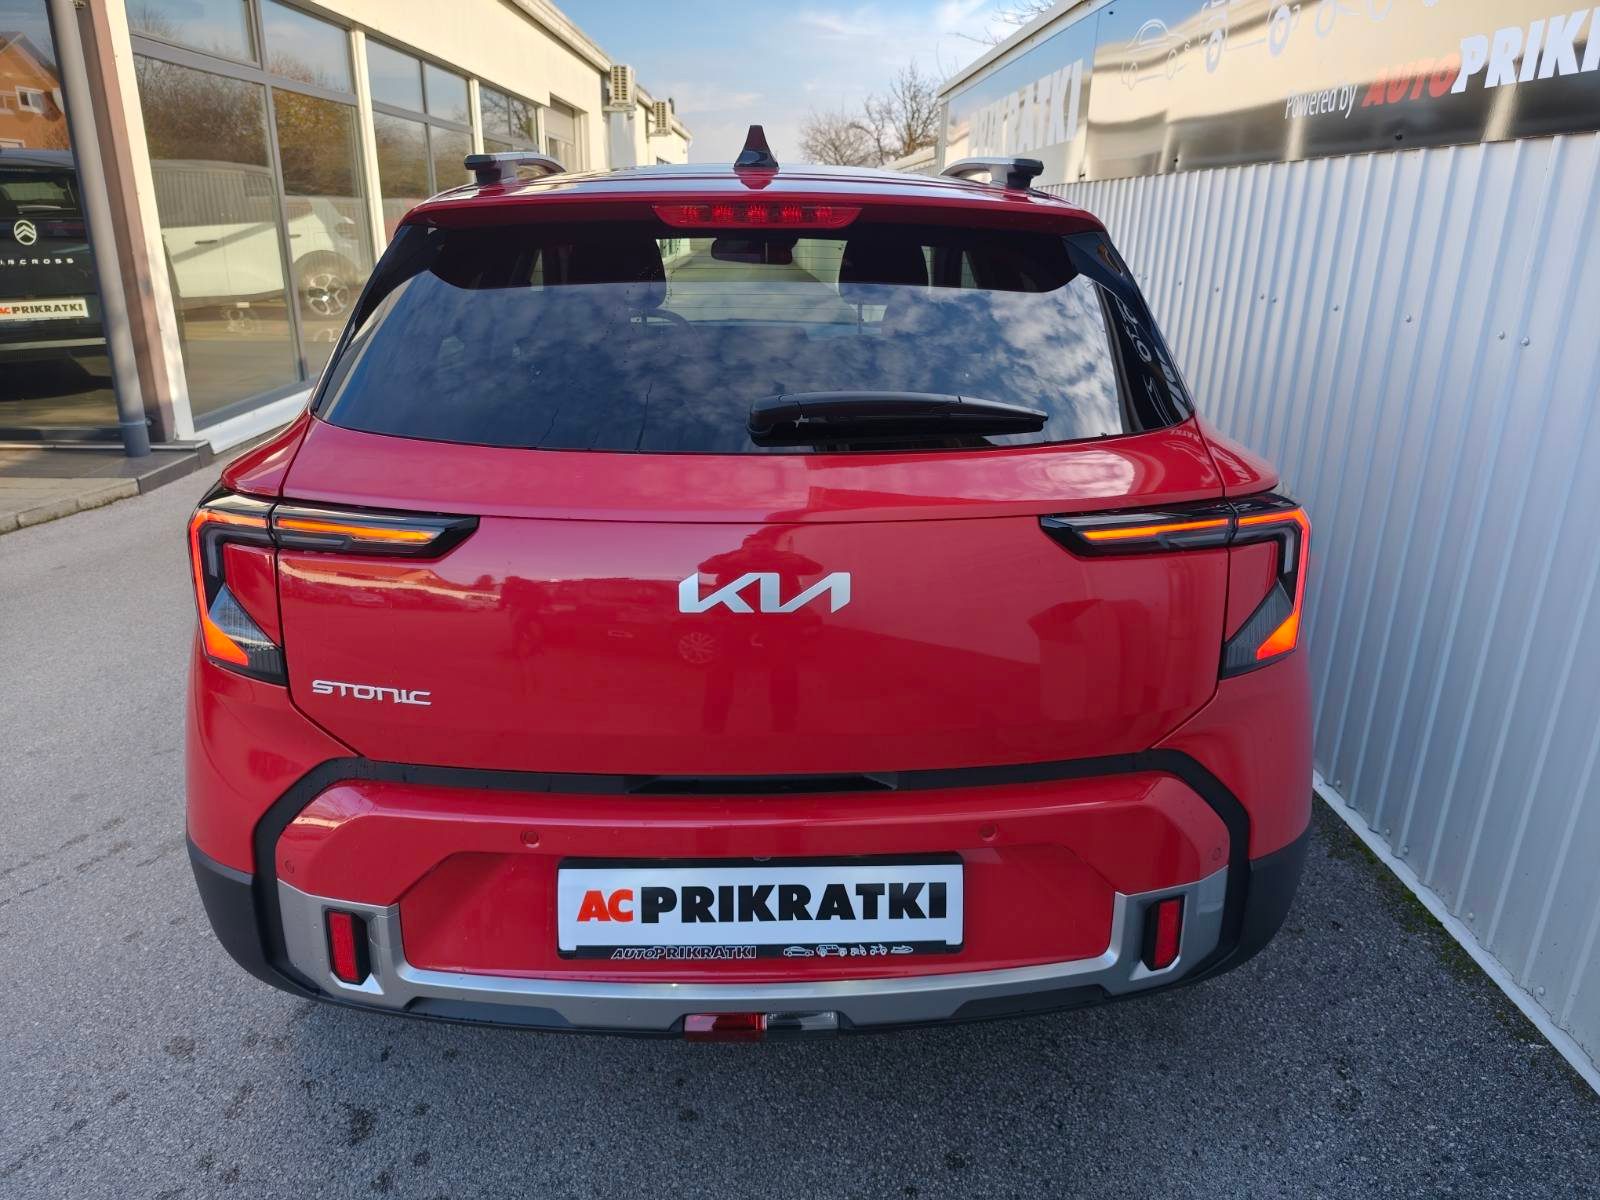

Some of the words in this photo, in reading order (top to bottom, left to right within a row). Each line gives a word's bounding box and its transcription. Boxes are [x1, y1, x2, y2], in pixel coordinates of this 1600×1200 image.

[1284, 81, 1338, 119] Powered
[1337, 78, 1358, 119] by
[678, 572, 851, 613] KIA
[311, 679, 432, 706] STONIC
